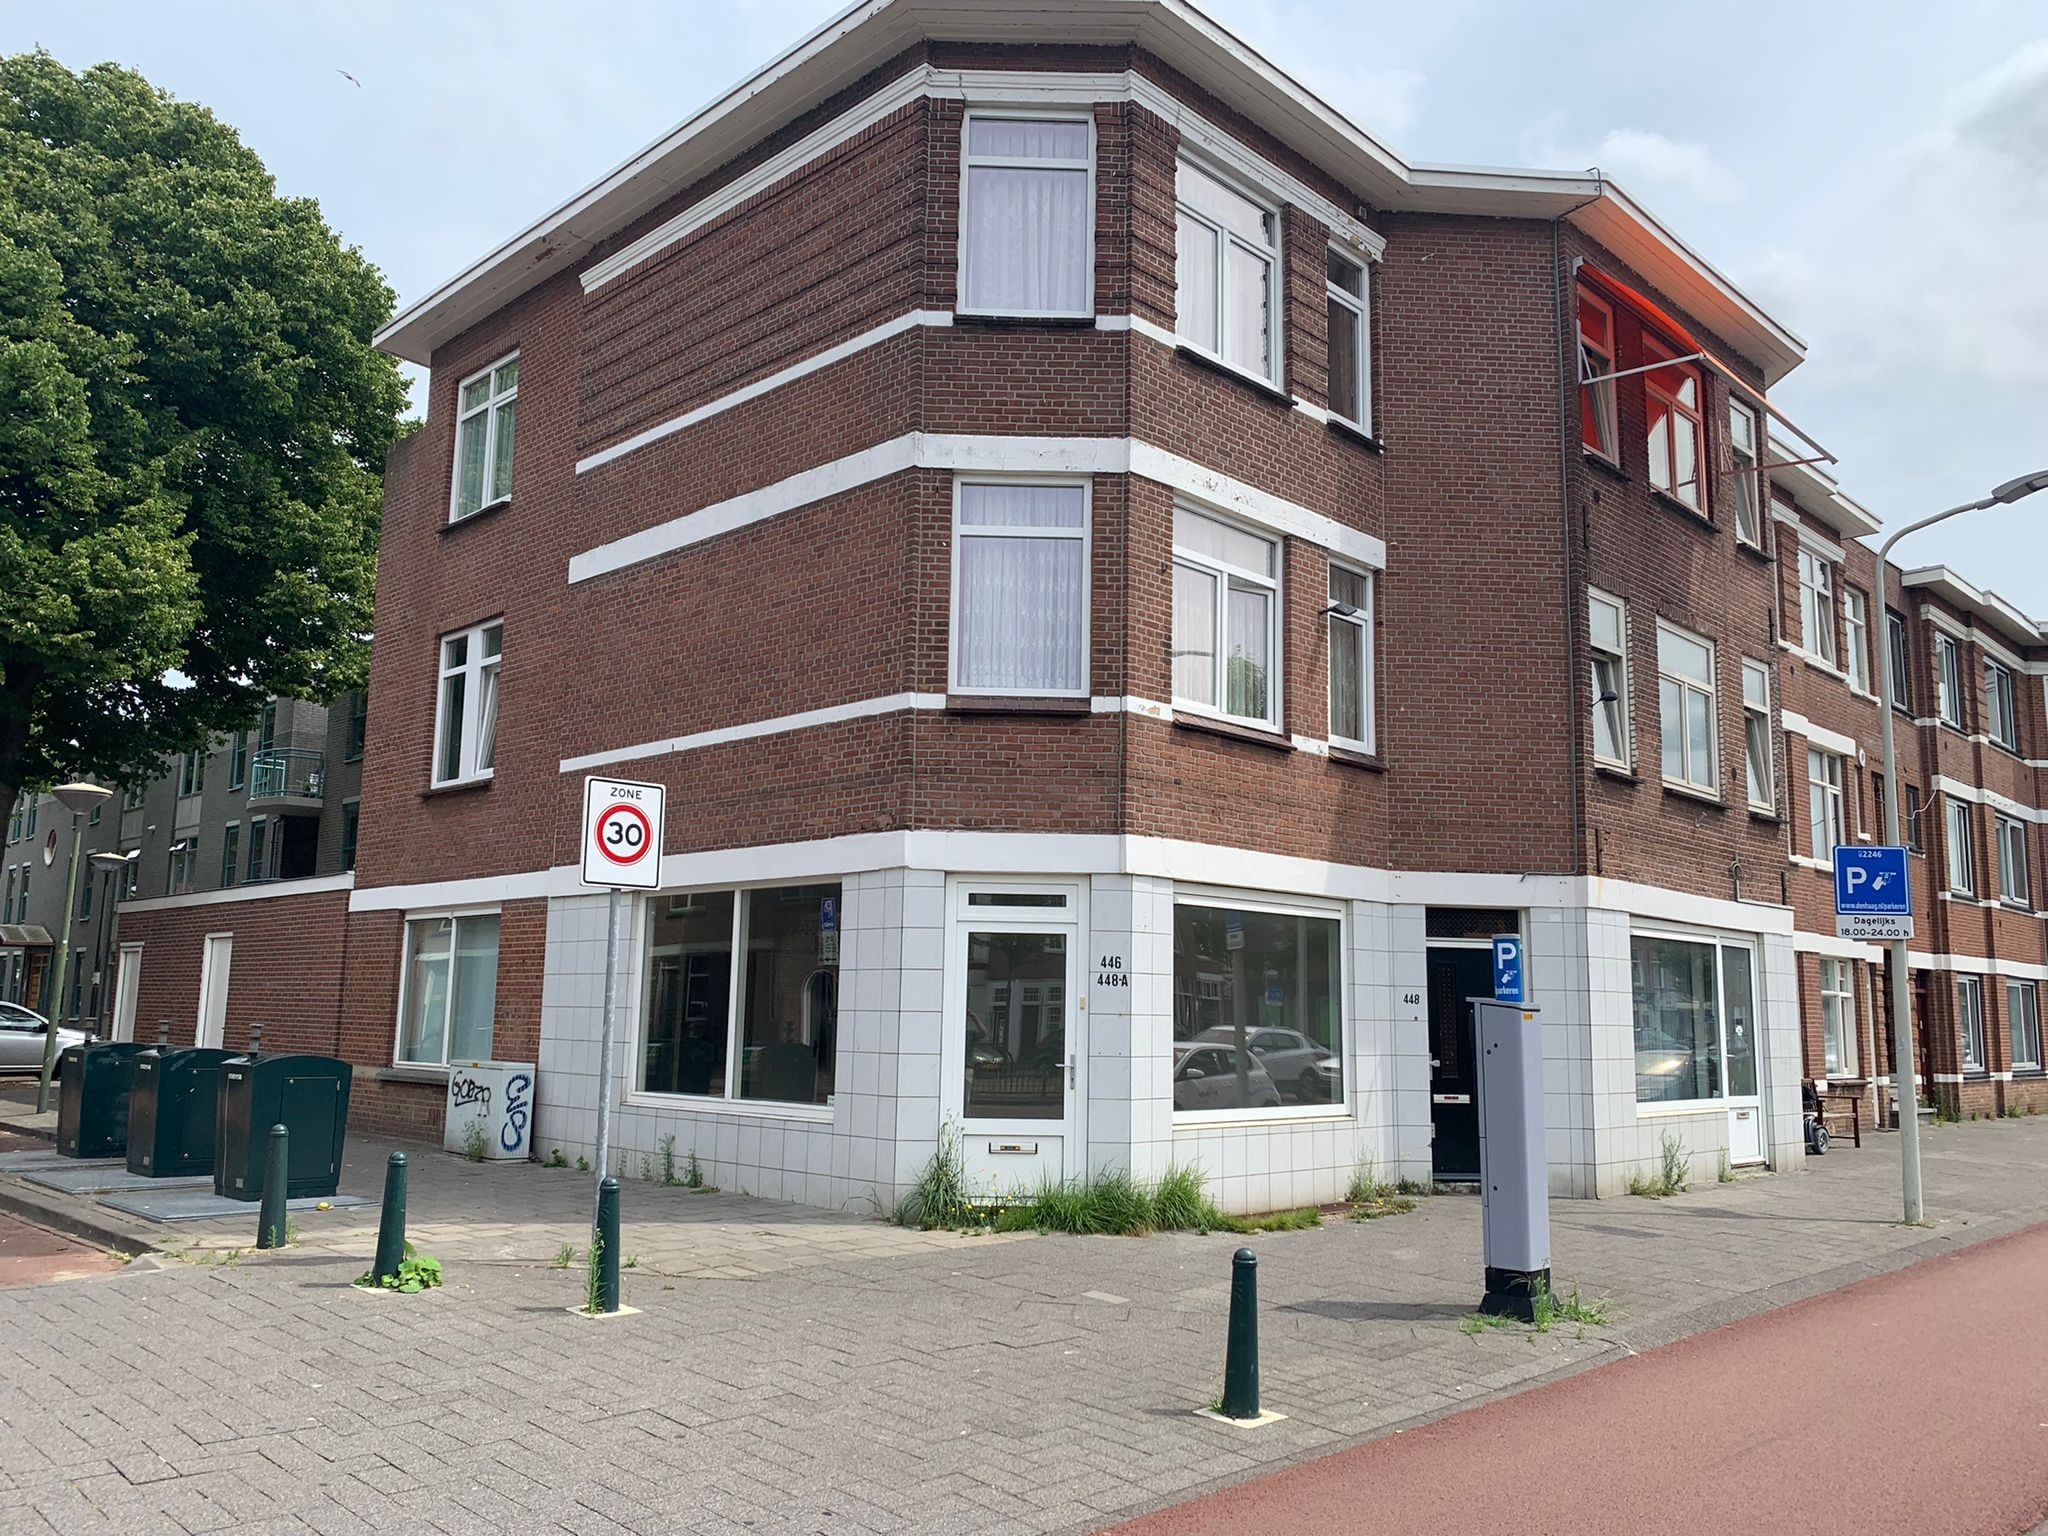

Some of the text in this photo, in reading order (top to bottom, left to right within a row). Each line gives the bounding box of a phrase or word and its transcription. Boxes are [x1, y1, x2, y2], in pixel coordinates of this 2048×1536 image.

[610, 787, 642, 800] ZONE
[606, 821, 643, 847] 30
[1846, 867, 1867, 894] P
[1853, 917, 1896, 926] Dagelijks
[1840, 928, 1909, 937] 18.00-24.00 h
[1100, 955, 1122, 969] 446
[1497, 943, 1517, 969] P
[1403, 993, 1420, 1005] 448
